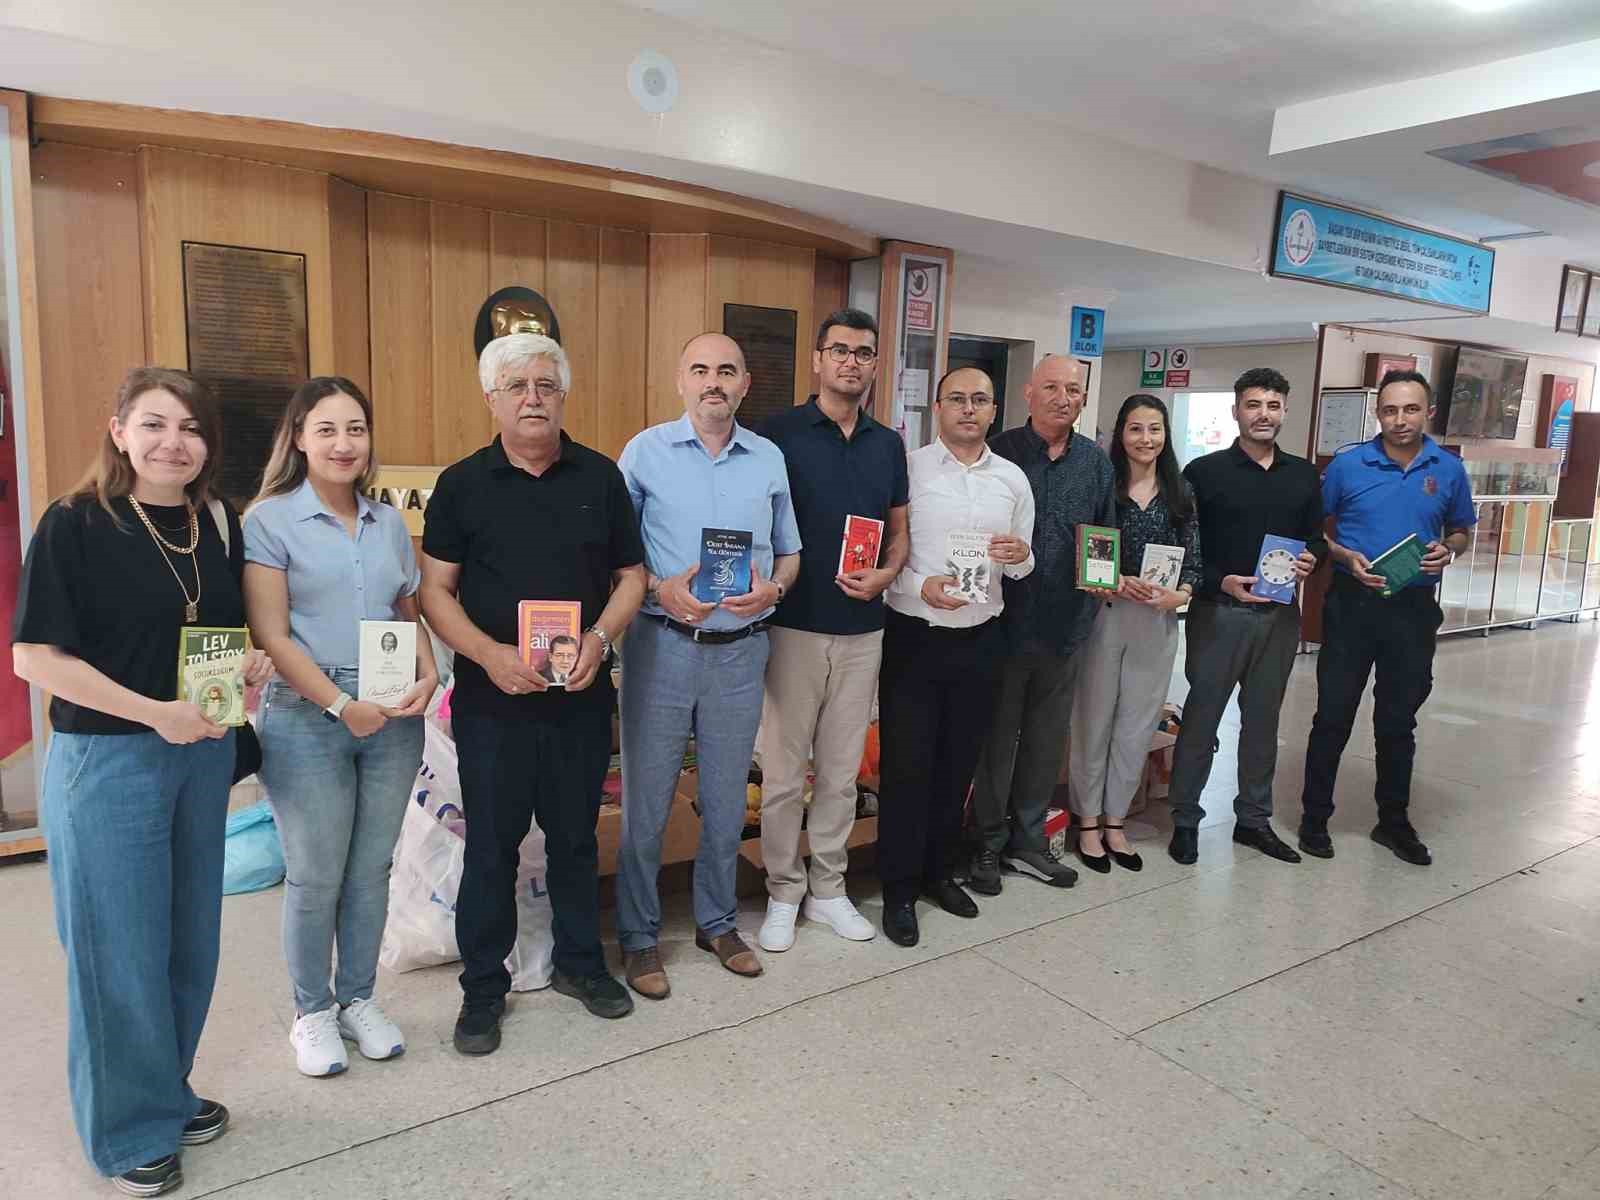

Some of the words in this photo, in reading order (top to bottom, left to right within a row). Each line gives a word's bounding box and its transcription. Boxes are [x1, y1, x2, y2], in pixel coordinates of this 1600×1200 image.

[1081, 313, 1095, 339] B
[1074, 342, 1097, 352] BLOK
[953, 549, 985, 558] KLON
[202, 633, 230, 652] LEV
